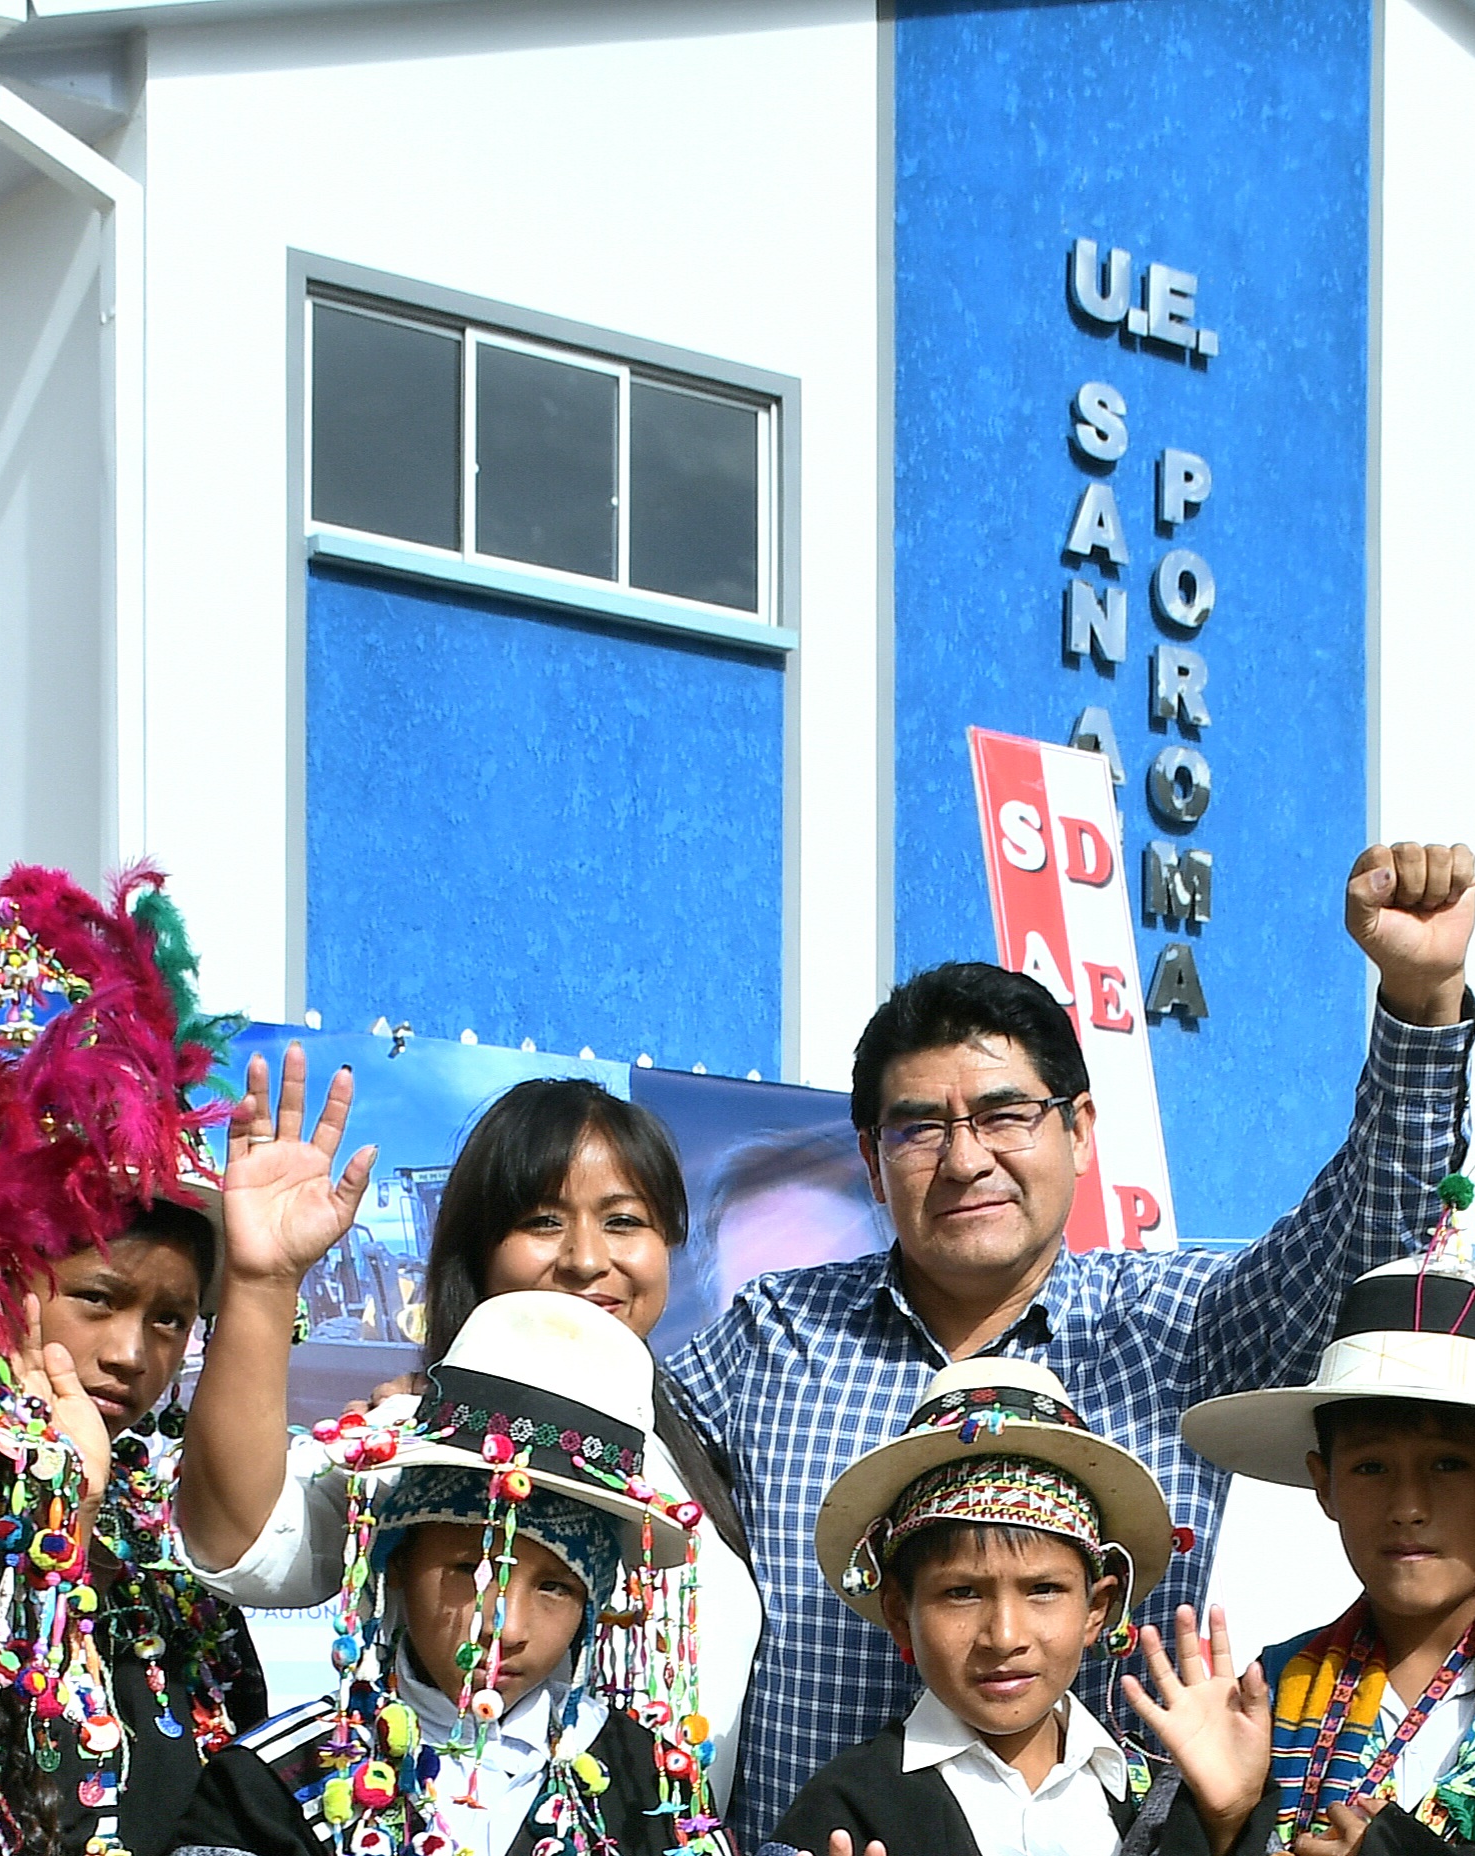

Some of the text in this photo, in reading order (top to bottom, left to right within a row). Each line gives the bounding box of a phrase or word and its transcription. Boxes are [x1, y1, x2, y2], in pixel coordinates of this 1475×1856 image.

[1069, 237, 1219, 358] U.E.
[1147, 447, 1216, 1019] POROMA
[999, 799, 1074, 1005] SA
